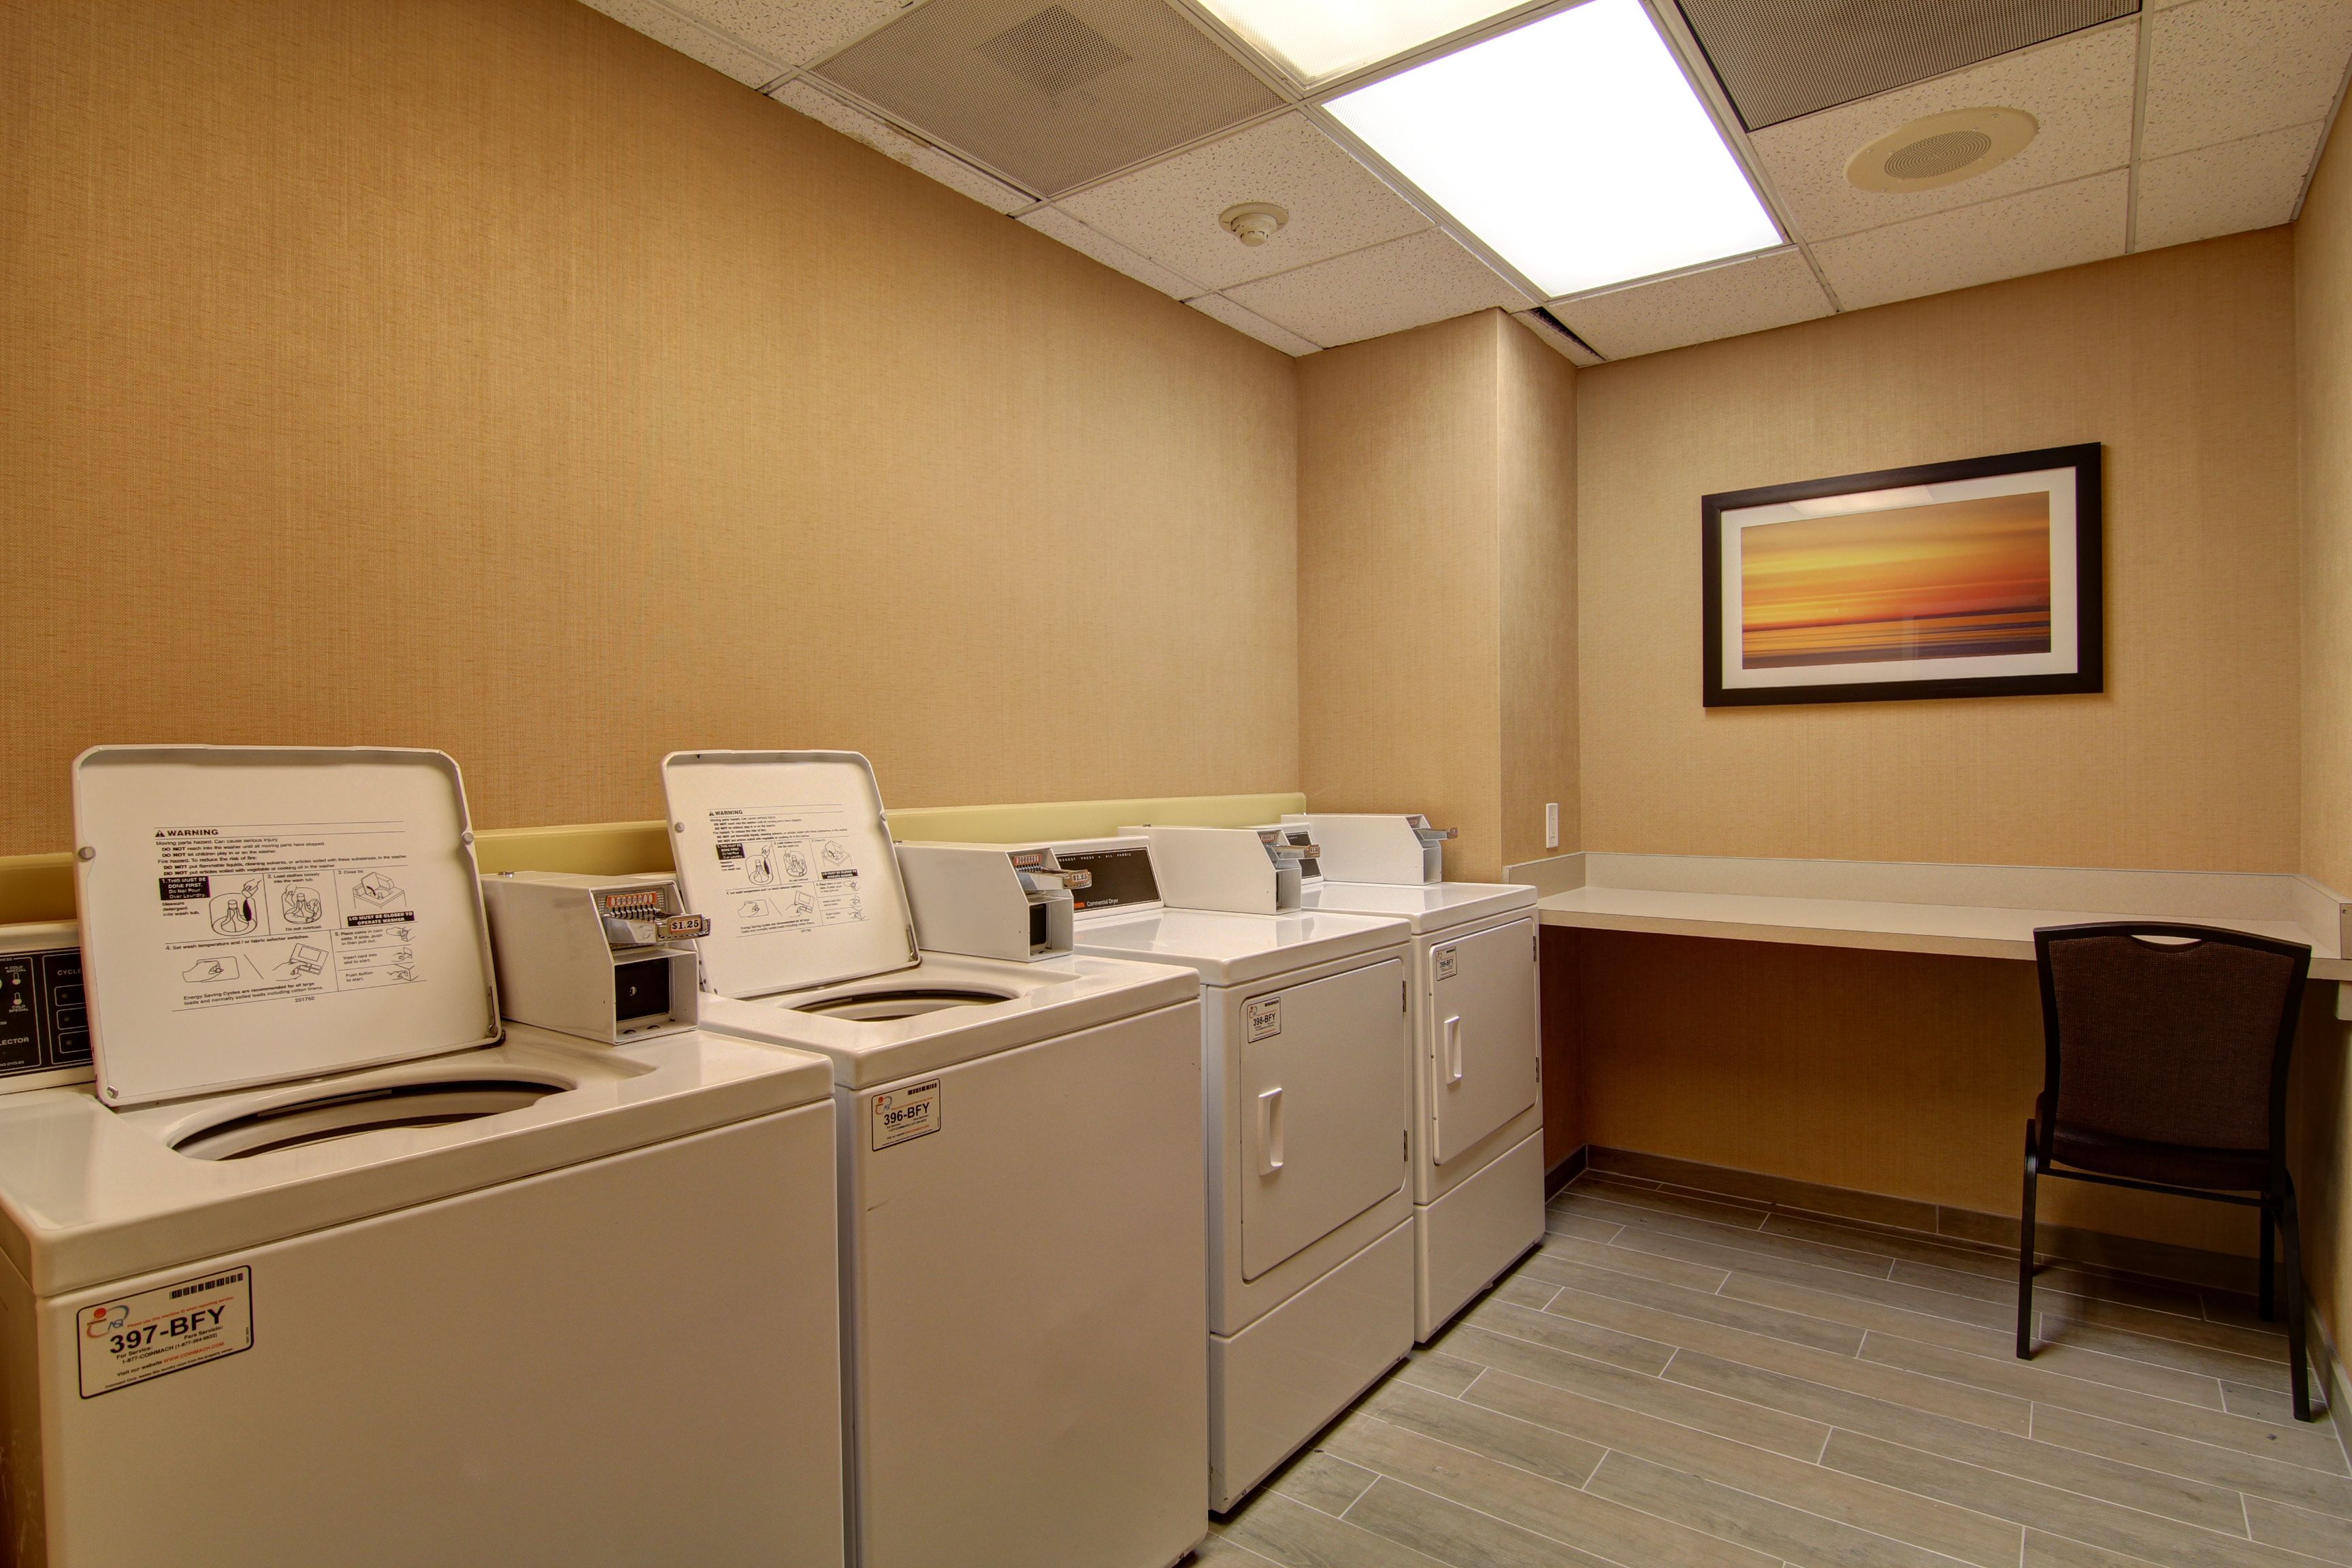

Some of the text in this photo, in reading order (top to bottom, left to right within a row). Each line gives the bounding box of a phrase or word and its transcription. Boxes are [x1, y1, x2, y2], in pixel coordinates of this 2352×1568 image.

[672, 919, 700, 930] $1.25
[884, 1102, 930, 1126] 396-BFY
[110, 1305, 226, 1354] 397-BFY
